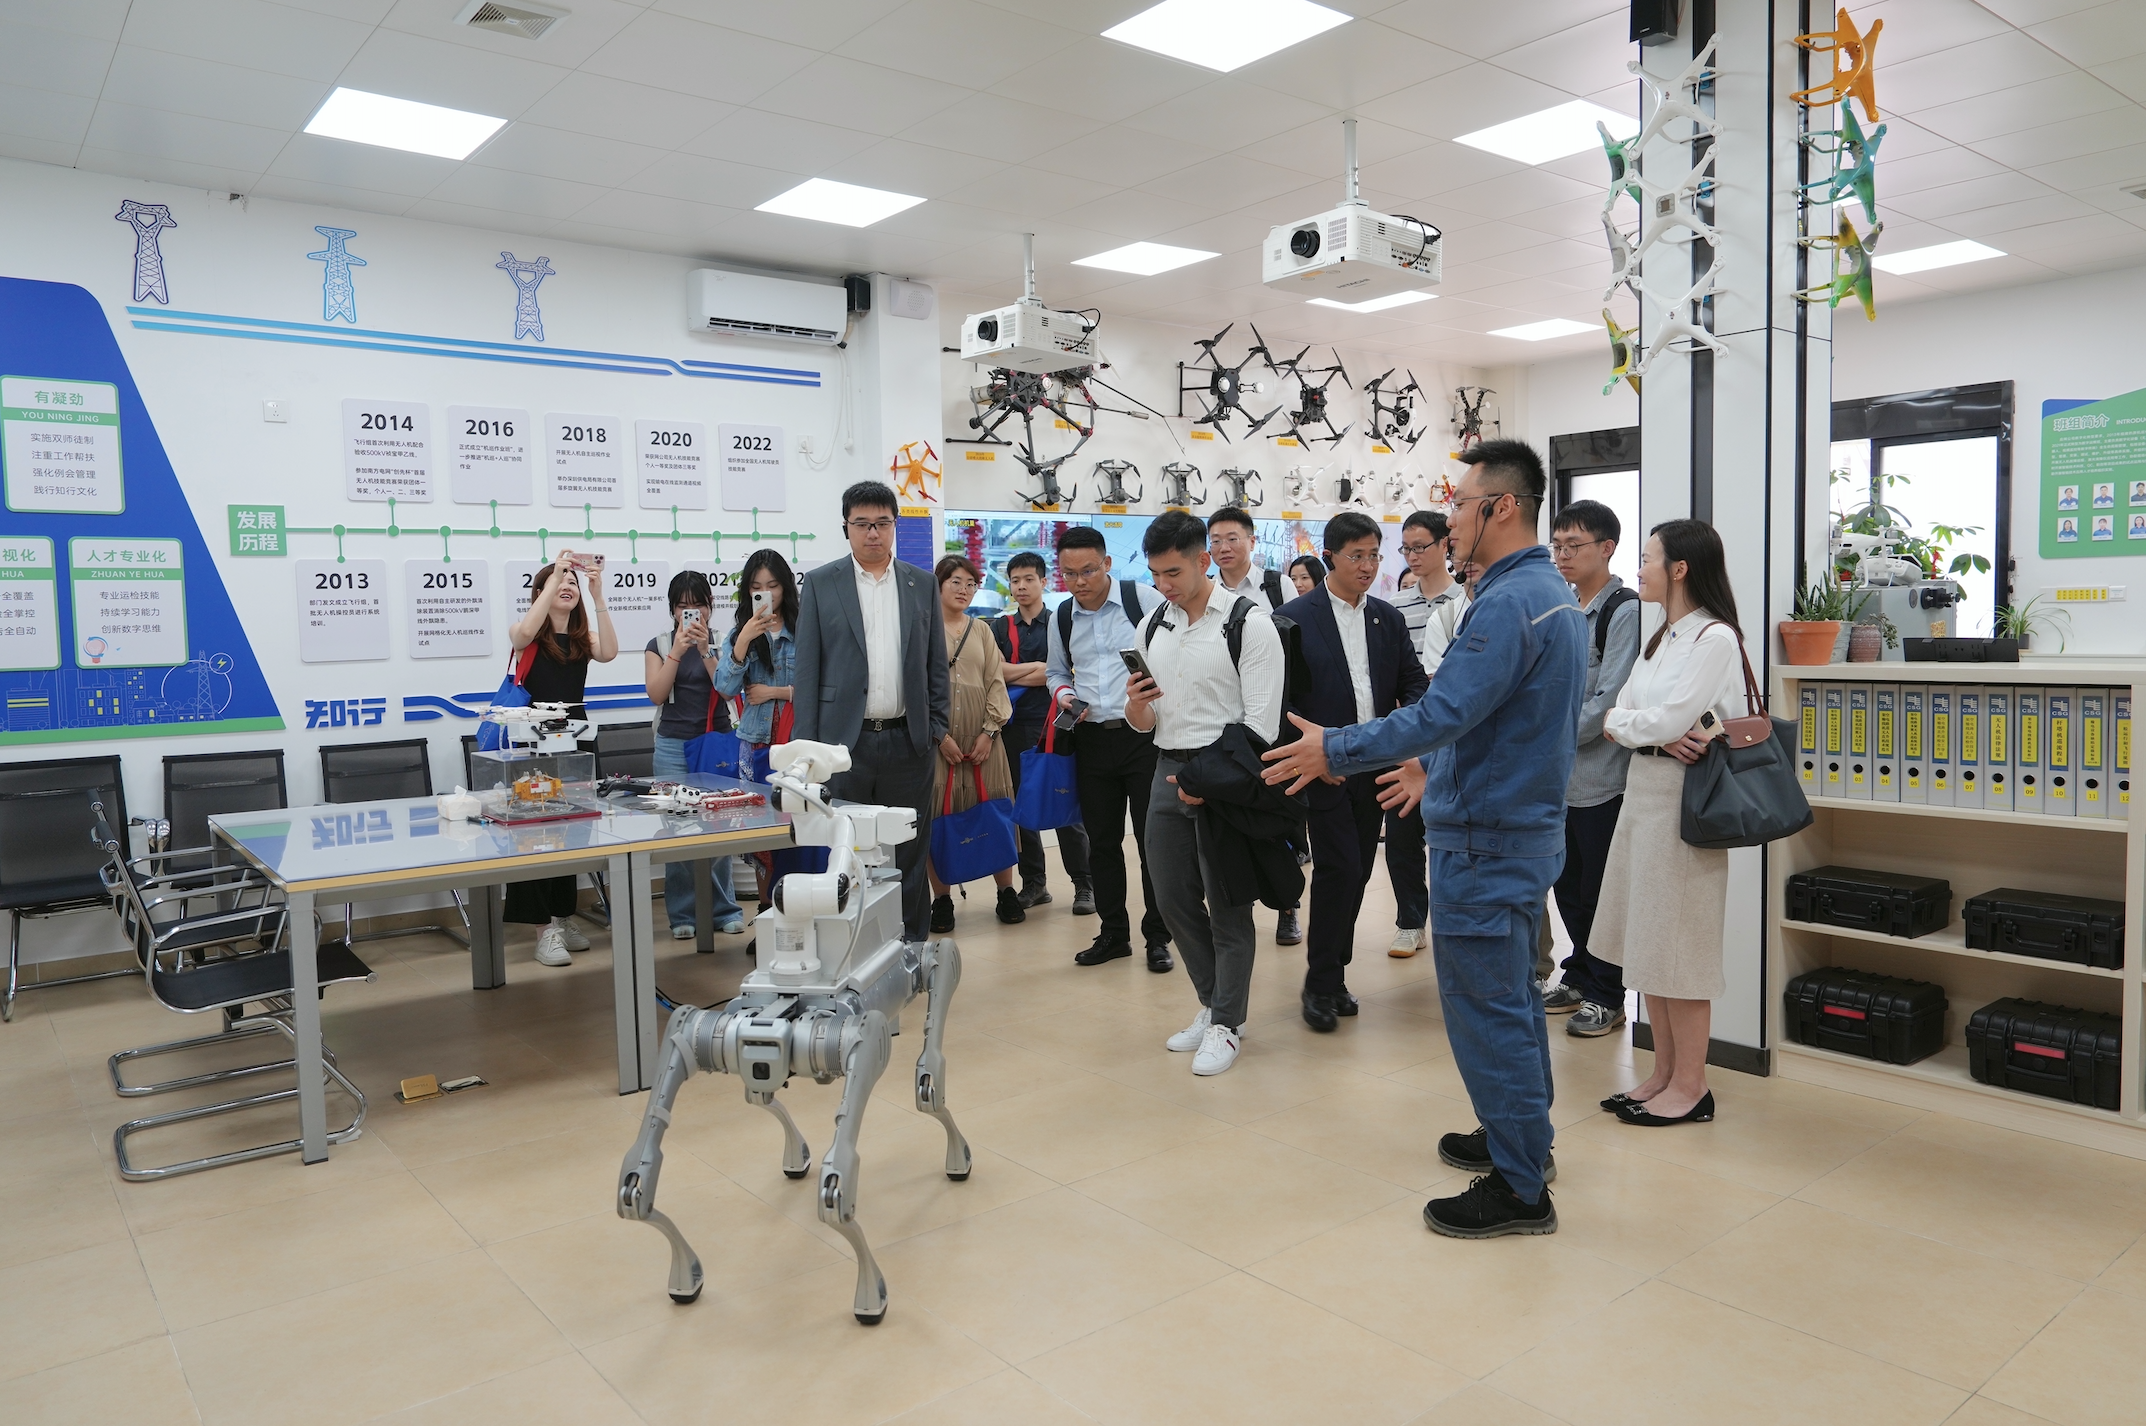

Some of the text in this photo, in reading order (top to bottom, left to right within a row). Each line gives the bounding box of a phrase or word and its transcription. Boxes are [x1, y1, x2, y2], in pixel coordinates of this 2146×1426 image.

[34, 389, 84, 407] 有凝劲
[21, 410, 99, 423] YOU NING JING
[361, 413, 414, 432] 2014
[2053, 413, 2110, 432] 班组简介
[2115, 417, 2146, 426] INTRODU
[465, 419, 514, 437] 2016
[561, 425, 607, 443] 2018
[30, 432, 95, 446] 实施双师徒制
[650, 430, 692, 447] 2020
[733, 435, 772, 451] 2022
[31, 449, 95, 463] 注重工作帮扶
[32, 467, 96, 481] 强化例会管理
[33, 484, 98, 497] 践行知行文化
[236, 510, 278, 530] 发展
[238, 532, 279, 552] 历程
[2, 548, 36, 562] 视化
[87, 549, 167, 563] 人才专业化
[1, 570, 25, 578] HUA
[91, 570, 165, 579] ZHUAN YE HUA
[422, 572, 473, 589] 2015
[613, 573, 657, 588] 2019
[315, 573, 369, 590] 2013
[0, 590, 34, 601] 全覆盖
[99, 590, 160, 601] 专业运检技能
[100, 607, 160, 618] 持续学习能力
[101, 624, 162, 635] 创新数字思维
[305, 697, 386, 729] 知行
